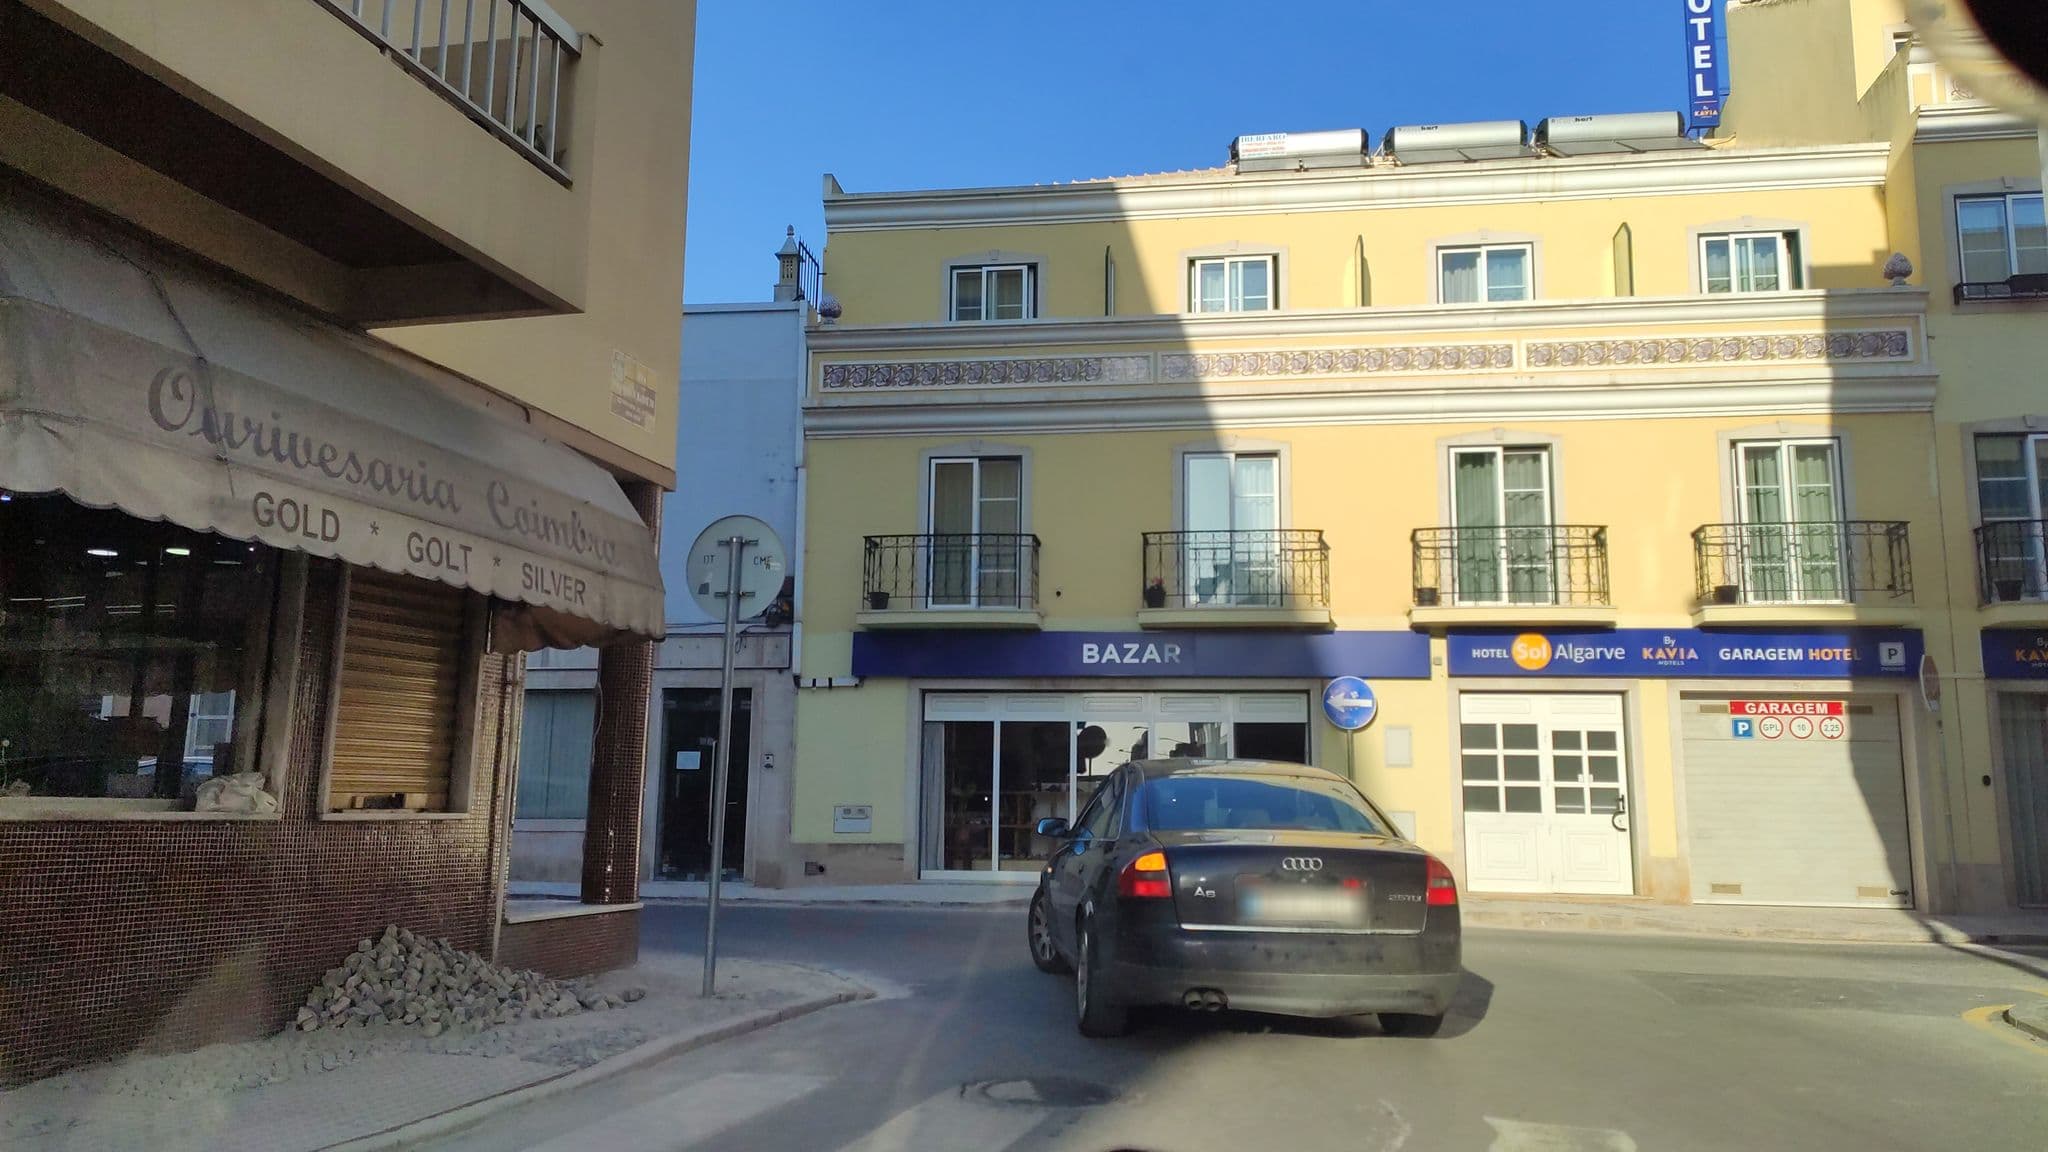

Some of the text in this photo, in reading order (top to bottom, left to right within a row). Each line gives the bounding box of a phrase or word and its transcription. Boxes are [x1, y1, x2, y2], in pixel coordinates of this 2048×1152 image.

[148, 366, 618, 568] Ourivesaria Coimbra
[253, 491, 587, 606] GOLD GOLT SILVER
[1663, 635, 1677, 648] By
[1082, 643, 1181, 664] BAZAR
[1471, 643, 1626, 664] HOTEL Sol Algarve
[1642, 647, 1699, 660] KAVIA
[1718, 648, 1862, 661] GARAGEM HOTEL
[1888, 648, 1898, 660] P
[1744, 702, 1829, 714] GARAGEM
[1737, 722, 1749, 735] P
[1762, 723, 1780, 732] GPL
[1194, 886, 1216, 898] A6
